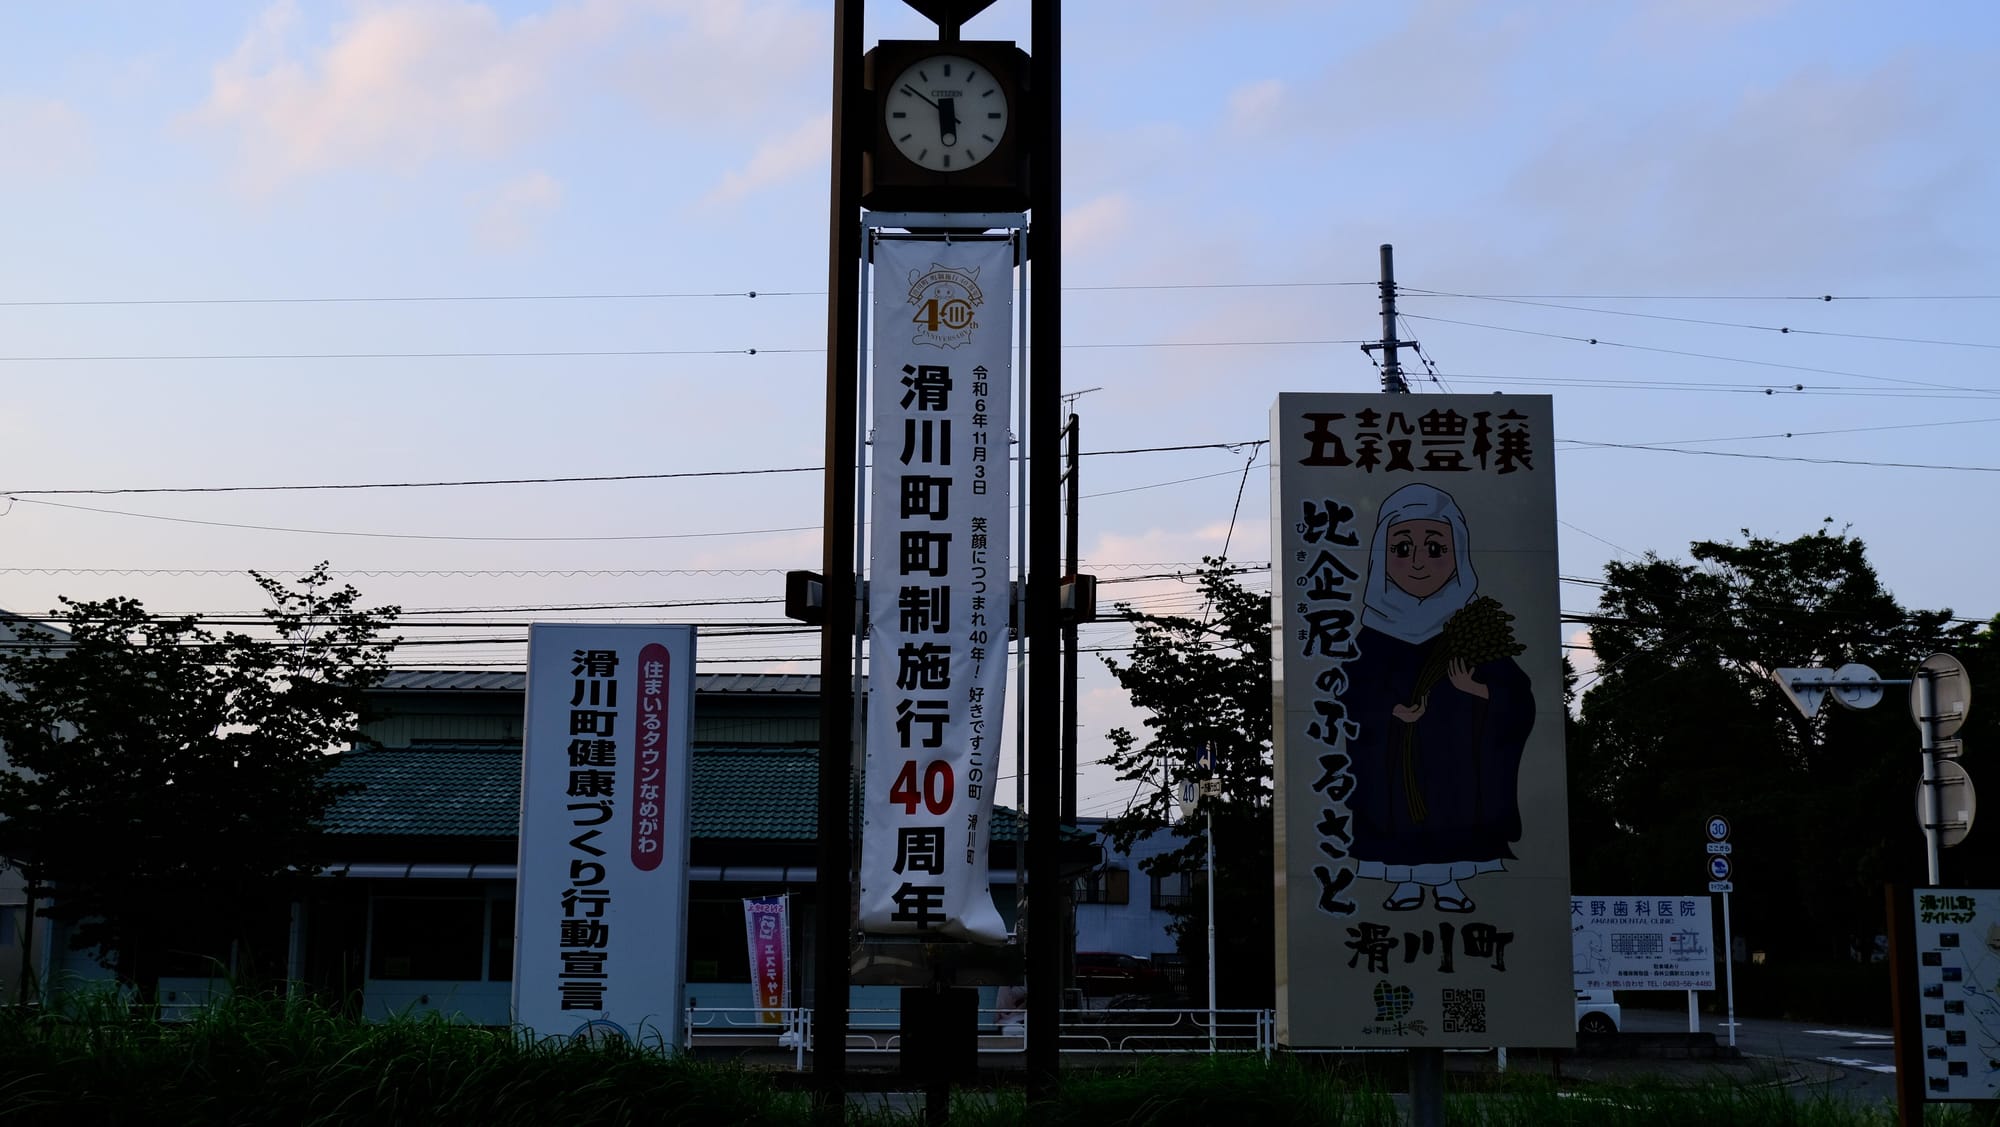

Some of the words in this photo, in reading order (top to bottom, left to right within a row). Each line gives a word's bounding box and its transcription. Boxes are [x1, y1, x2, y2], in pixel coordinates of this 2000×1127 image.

[972, 365, 988, 495] 令和6年11月3日
[1299, 408, 1533, 474] 五穀豊穣
[890, 364, 954, 929] 滑川町町制施行40周年
[1302, 500, 1361, 914] 比企尼のふるさと
[638, 660, 664, 853] 住まいるタウンなめがわ
[1183, 784, 1195, 803] 40
[559, 649, 619, 1010] 滑川町健康づくり行動宣言
[1712, 822, 1725, 835] 30
[1571, 901, 1696, 916] 天野歯科医院
[1921, 911, 1977, 924] ガイドマップ
[1345, 923, 1514, 973] 滑川町
